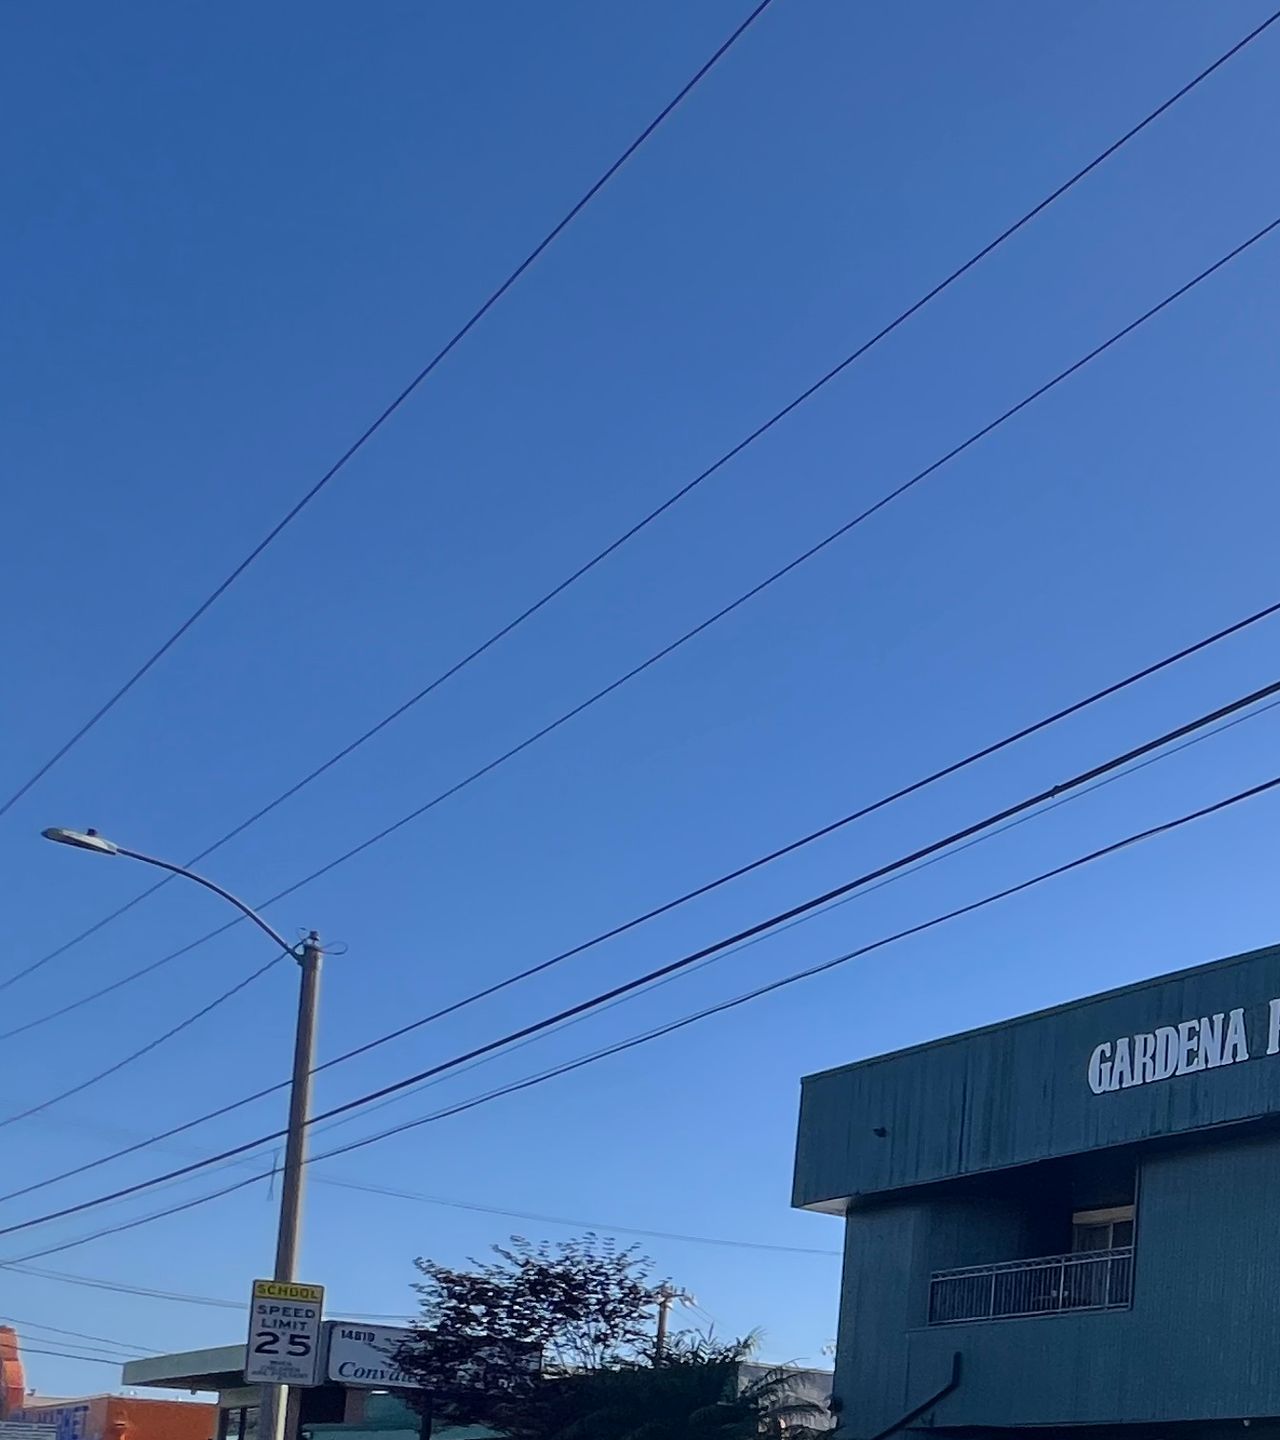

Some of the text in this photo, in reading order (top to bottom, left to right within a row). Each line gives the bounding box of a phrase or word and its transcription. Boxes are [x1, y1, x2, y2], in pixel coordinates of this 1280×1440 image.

[1087, 1007, 1249, 1094] GARDENA
[256, 1283, 319, 1300] SCHOOL
[256, 1304, 316, 1319] SPEED
[261, 1318, 308, 1331] LIMIT
[254, 1331, 312, 1357] 25
